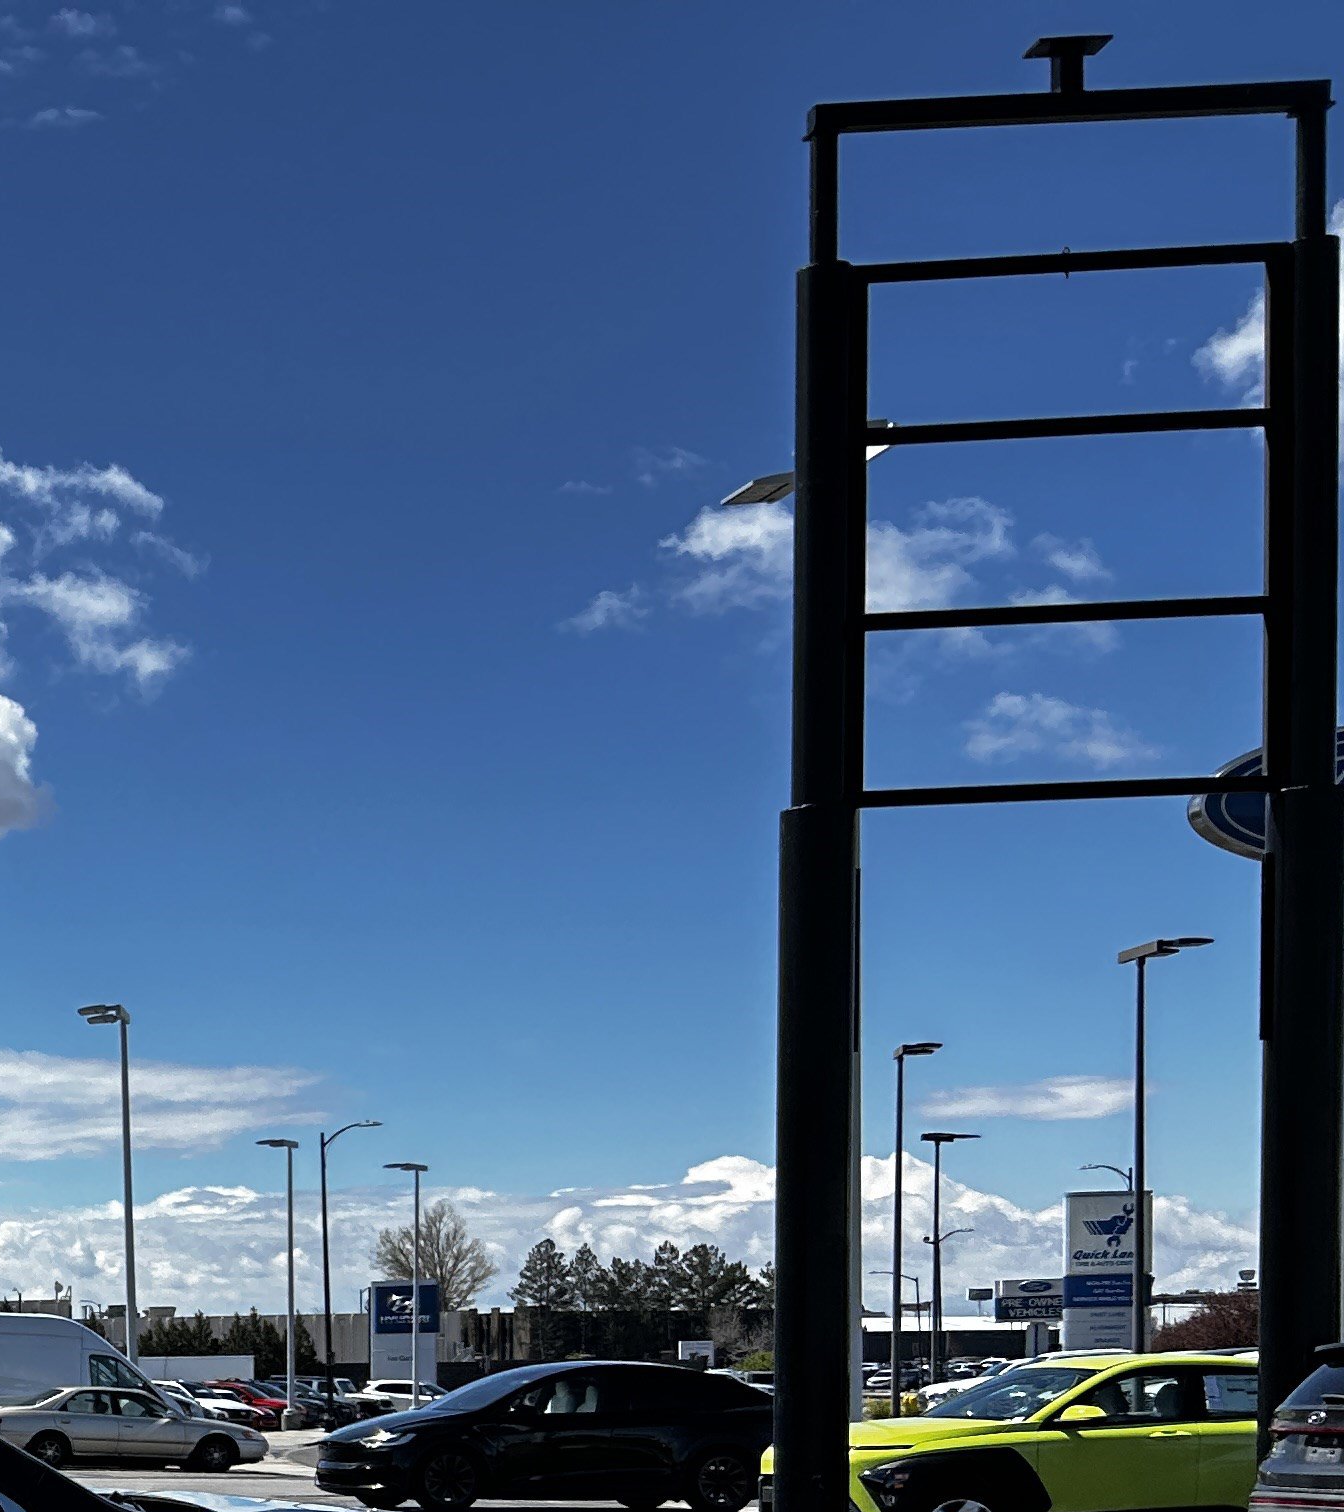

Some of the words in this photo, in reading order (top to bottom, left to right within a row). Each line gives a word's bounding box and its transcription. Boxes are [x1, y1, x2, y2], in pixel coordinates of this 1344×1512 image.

[1072, 1249, 1110, 1260] Quick
[1111, 1249, 1134, 1259] Lan
[1028, 1297, 1063, 1307] OWNE
[1008, 1307, 1063, 1318] VEHICLES
[380, 1315, 430, 1325] HYUNAI
